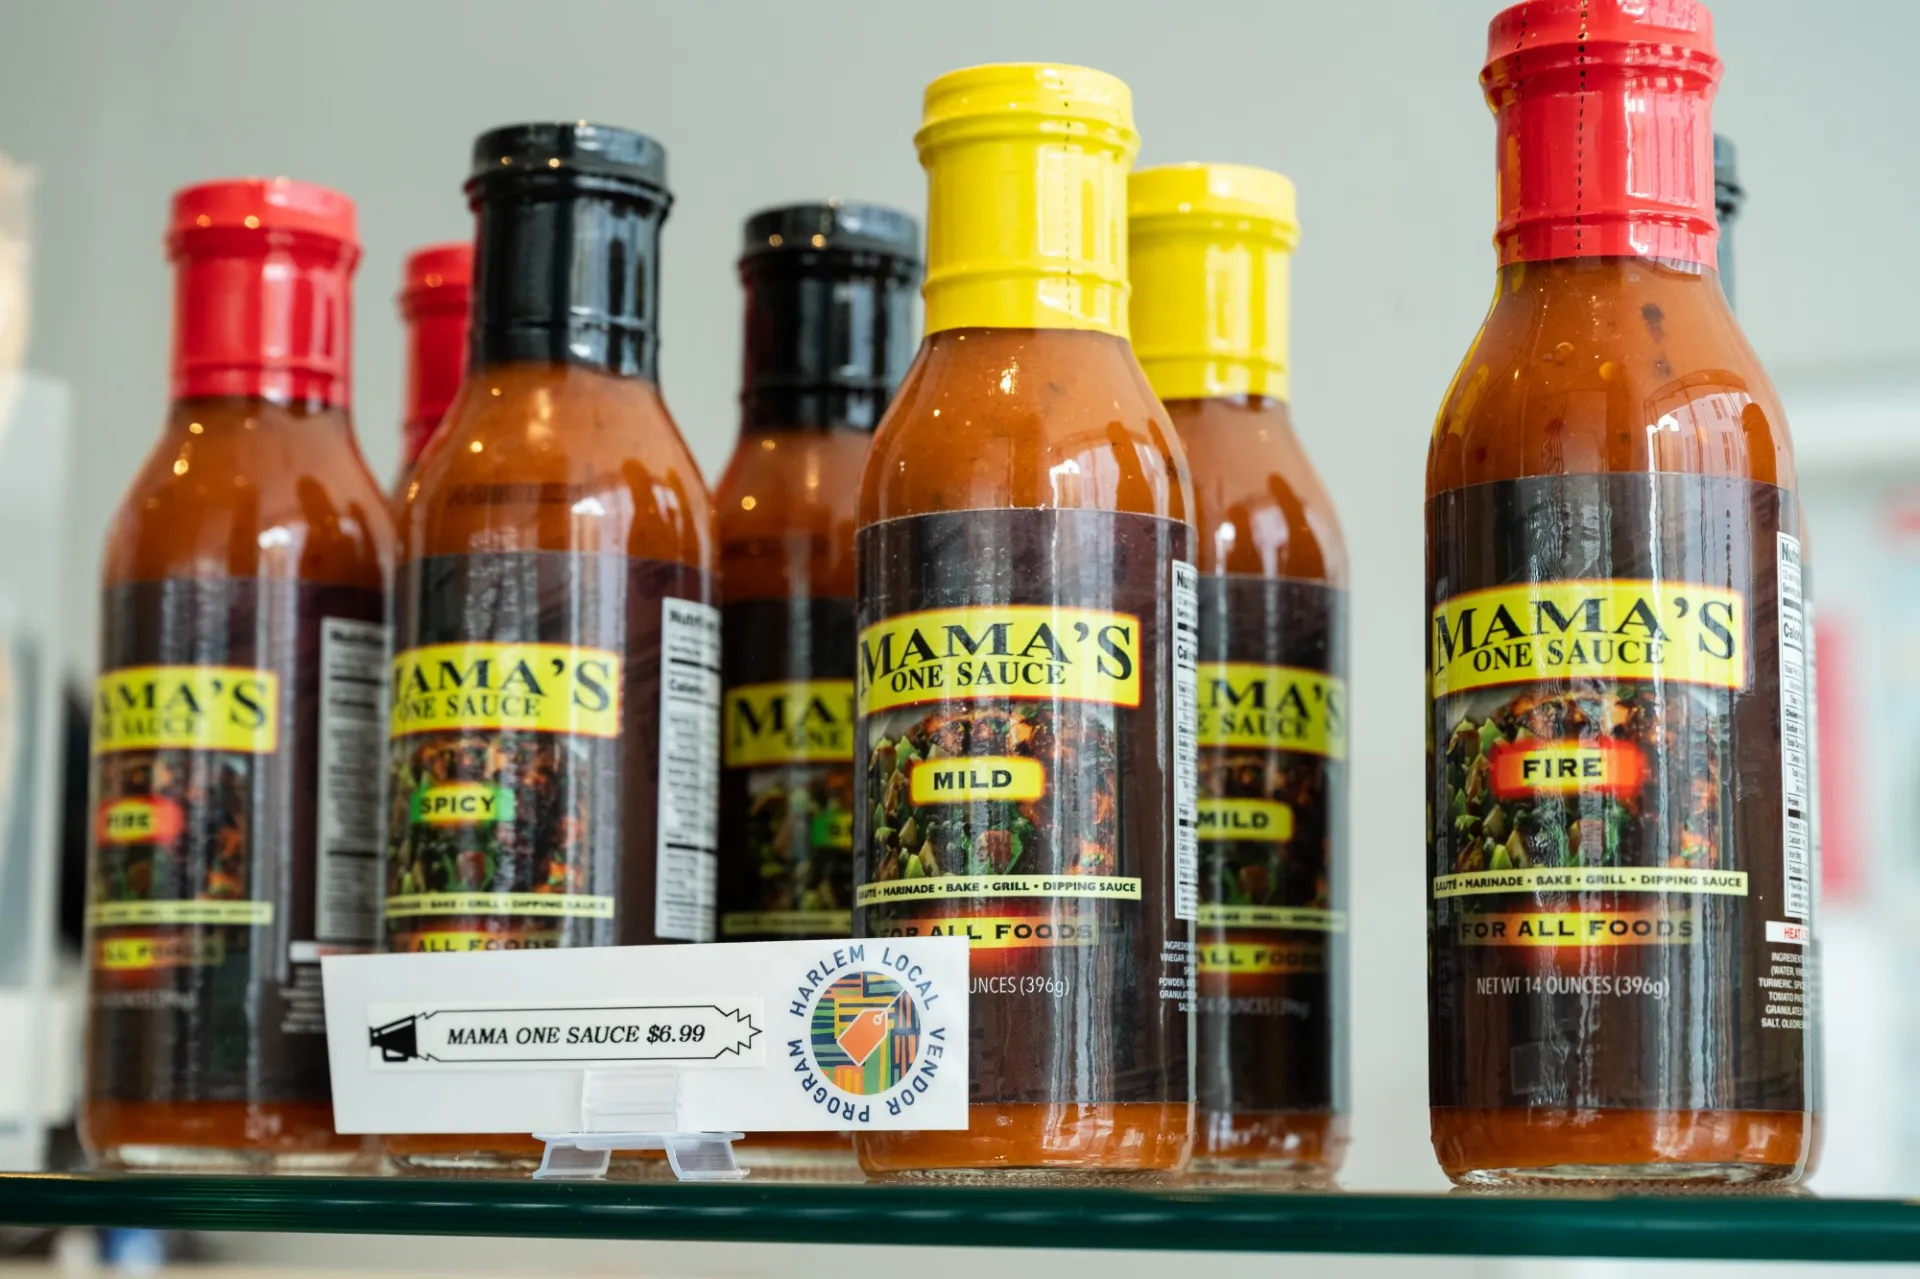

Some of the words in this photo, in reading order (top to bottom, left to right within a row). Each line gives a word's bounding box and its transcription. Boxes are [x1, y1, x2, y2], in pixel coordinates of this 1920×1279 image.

[1433, 596, 1737, 676] MAMA'S
[860, 621, 1133, 697] MAMA'S
[1472, 641, 1533, 673] ONE
[1545, 637, 1665, 666] SAUCE
[891, 664, 944, 694] ONE
[956, 660, 1067, 687] SAUCE
[445, 694, 542, 718] SAUCE
[1220, 711, 1310, 741] SAUCE
[933, 768, 1013, 790] MILD
[1522, 755, 1604, 779] FIRE
[418, 796, 496, 815] SPICY
[883, 883, 935, 897] MARINADE
[945, 882, 980, 893] BAKE
[992, 881, 1030, 892] GRILL
[1042, 880, 1097, 892] DIPPING
[1099, 881, 1136, 893] SAUCE
[1465, 876, 1524, 889] MARINADE
[1535, 875, 1573, 886] BAKE
[1585, 874, 1626, 886] GRILL
[1640, 874, 1699, 886] DIPPING
[1702, 876, 1743, 888] SAUCE
[929, 923, 983, 940] ALL
[994, 923, 1094, 940] FOODS
[1461, 920, 1508, 939] FOR
[1517, 919, 1576, 938] ALL
[1588, 919, 1695, 938] FOODS
[789, 944, 865, 1017] HARLEM
[881, 947, 939, 1011] LOCAL
[969, 976, 1017, 994] UNCES
[1019, 975, 1070, 998] (396g)
[1476, 977, 1499, 995] NET
[1500, 976, 1520, 994] WT
[1524, 976, 1541, 994] 14
[1545, 975, 1612, 995] OUNCES
[1614, 975, 1671, 999] (396g)
[1768, 991, 1793, 1003] TOMATO
[446, 1026, 509, 1045] MAMA
[516, 1025, 560, 1044] ONE
[566, 1024, 640, 1044] SAUCE
[646, 1023, 706, 1044] $6.99
[787, 1039, 870, 1122] PROGRAM
[885, 1027, 946, 1116] VENDOR
